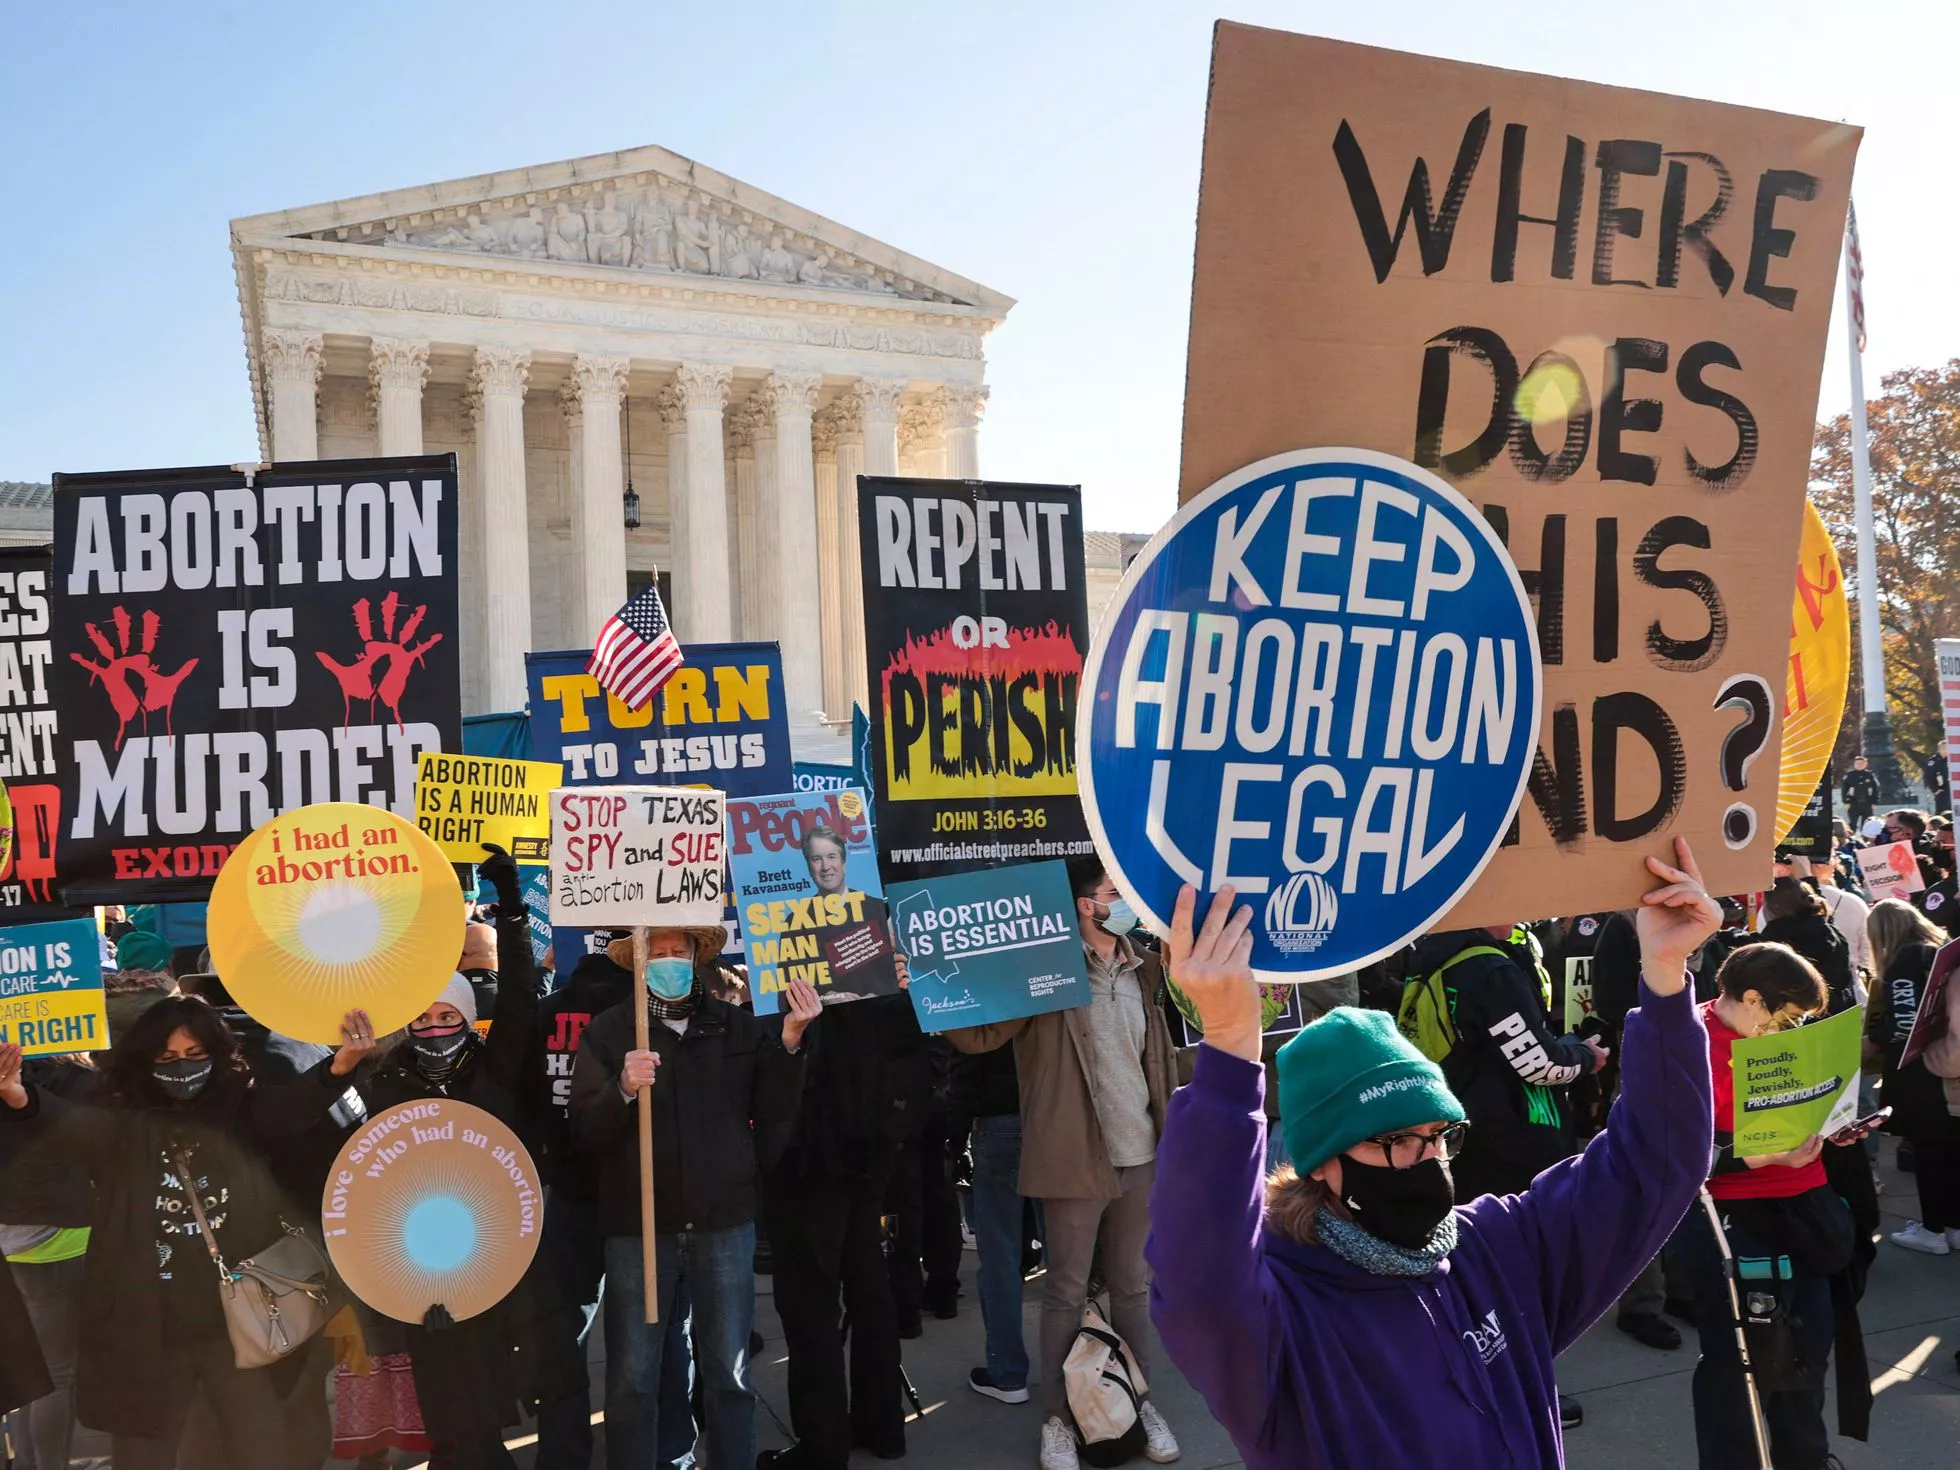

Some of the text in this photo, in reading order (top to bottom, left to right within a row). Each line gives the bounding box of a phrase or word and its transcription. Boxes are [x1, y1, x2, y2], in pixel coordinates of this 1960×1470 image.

[1332, 107, 1819, 311] WHERE
[1413, 326, 1759, 494] DOES
[68, 479, 443, 595] ABORTION
[875, 495, 1069, 591] REPENT
[1208, 476, 1475, 621] KEEP
[1468, 499, 1728, 672] HIS
[952, 615, 1010, 650] OR
[217, 607, 297, 710] IS
[1115, 608, 1517, 766] ABORTION
[888, 669, 1078, 785] PERISH
[421, 758, 526, 789] ABORTION
[561, 733, 766, 780] TO JESUS
[1713, 673, 1776, 851] ?
[70, 722, 442, 840] MURDER
[421, 787, 538, 818] IS A HUMAN
[560, 794, 718, 831] STOP TEXAS
[932, 808, 1047, 833] JOHN 3:16-36
[271, 823, 398, 853] i had an
[418, 816, 485, 843] RIGHT
[724, 794, 867, 855] People
[1145, 759, 1466, 894] LEGAL
[256, 849, 419, 886] abortion.
[565, 831, 721, 872] SPY and SUE
[890, 838, 1095, 864] www.officialstreetpreachers.com
[560, 877, 644, 907] abortion
[562, 873, 596, 884] anti-
[742, 878, 811, 896] Kavanaugh
[758, 868, 792, 883] Brett
[747, 891, 866, 936] SEXIST
[908, 895, 1033, 934] ABORTION
[1264, 873, 1339, 931] NOW
[751, 934, 820, 967] MAN
[910, 912, 1071, 957] IS ESSENTIAL
[45, 942, 72, 969] IS
[1, 974, 39, 995] CARE
[759, 961, 833, 995] ALIVE
[1028, 974, 1053, 984] CENTER
[1029, 977, 1077, 991] REPRODUCTIVE
[1031, 987, 1054, 997] RIGHTS
[36, 1000, 49, 1016] IS
[19, 1014, 96, 1047] RIGHT
[1747, 1088, 1814, 1108] PRO-ABORTION
[349, 1103, 441, 1164] someone
[324, 1170, 353, 1218] love
[366, 1121, 538, 1237] who had an abortion.
[325, 1228, 347, 1238] i
